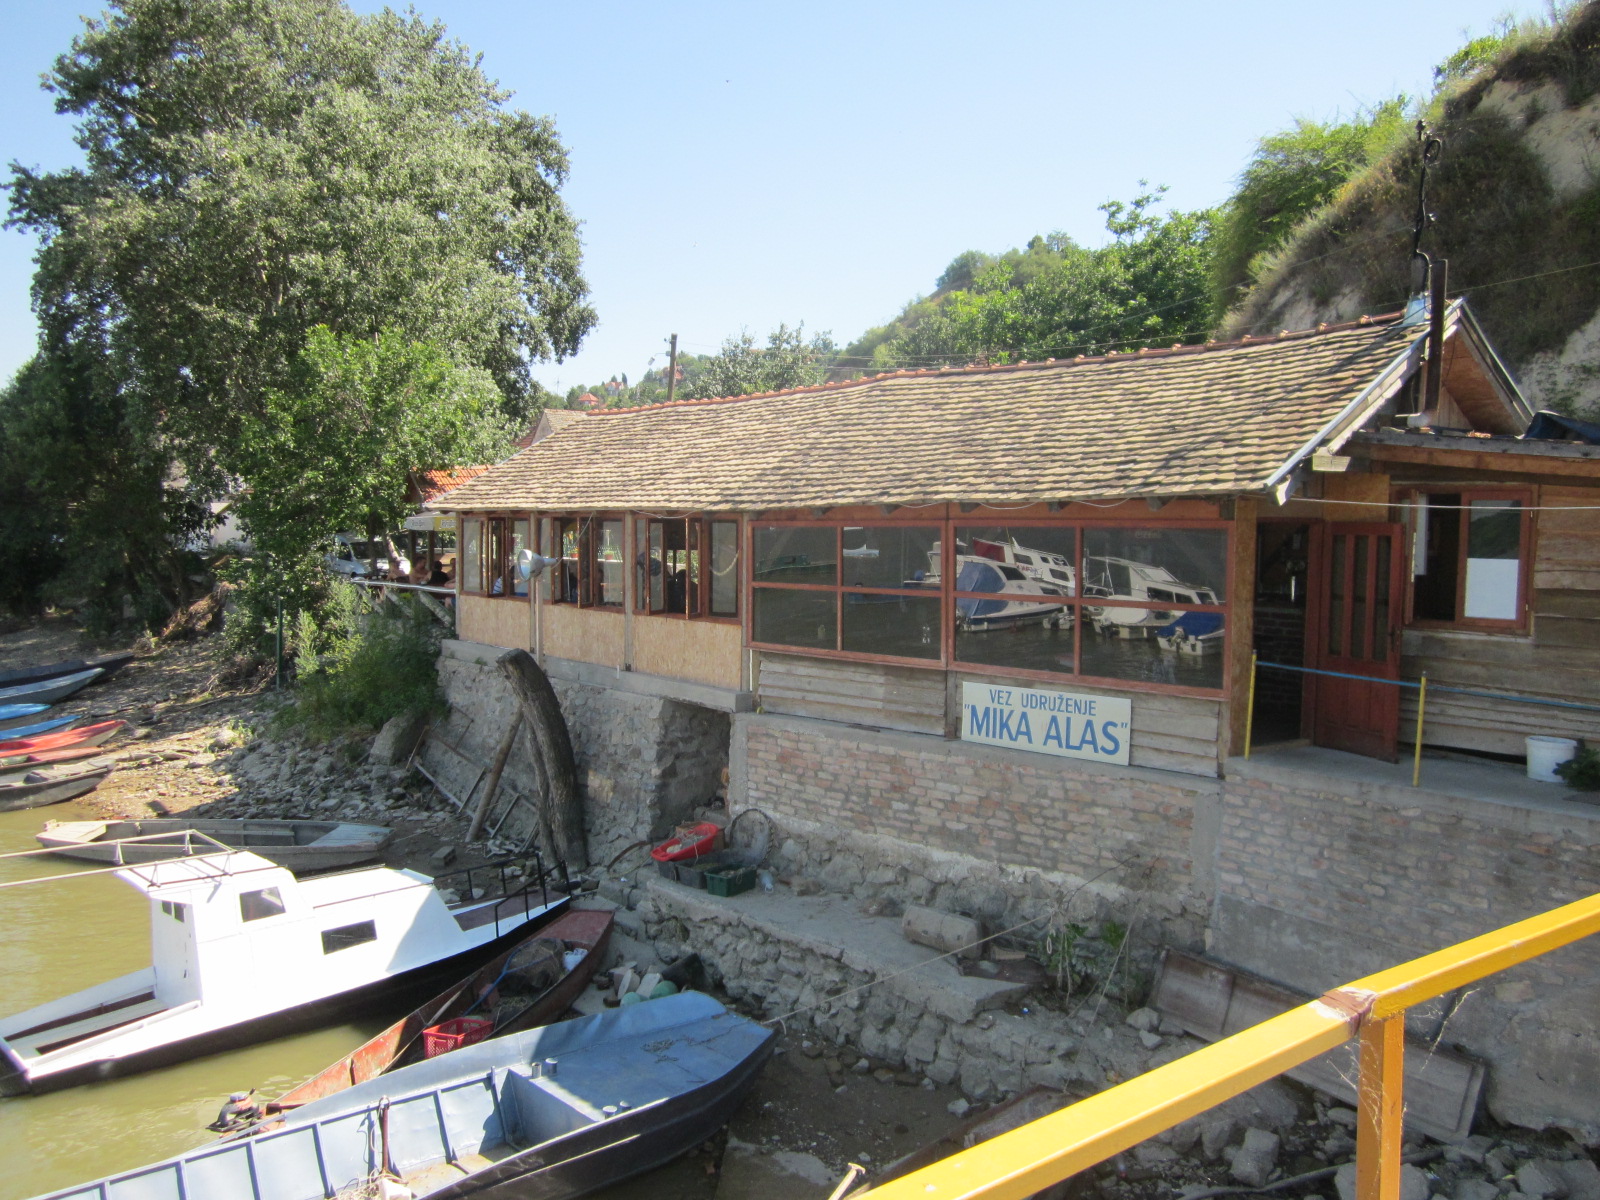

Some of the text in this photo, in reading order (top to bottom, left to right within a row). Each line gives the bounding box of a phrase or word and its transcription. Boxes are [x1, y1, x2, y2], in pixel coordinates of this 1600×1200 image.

[989, 689, 1096, 716] VEZ UDRUŽENJE
[964, 704, 1127, 755] "MIKA ALAS"
